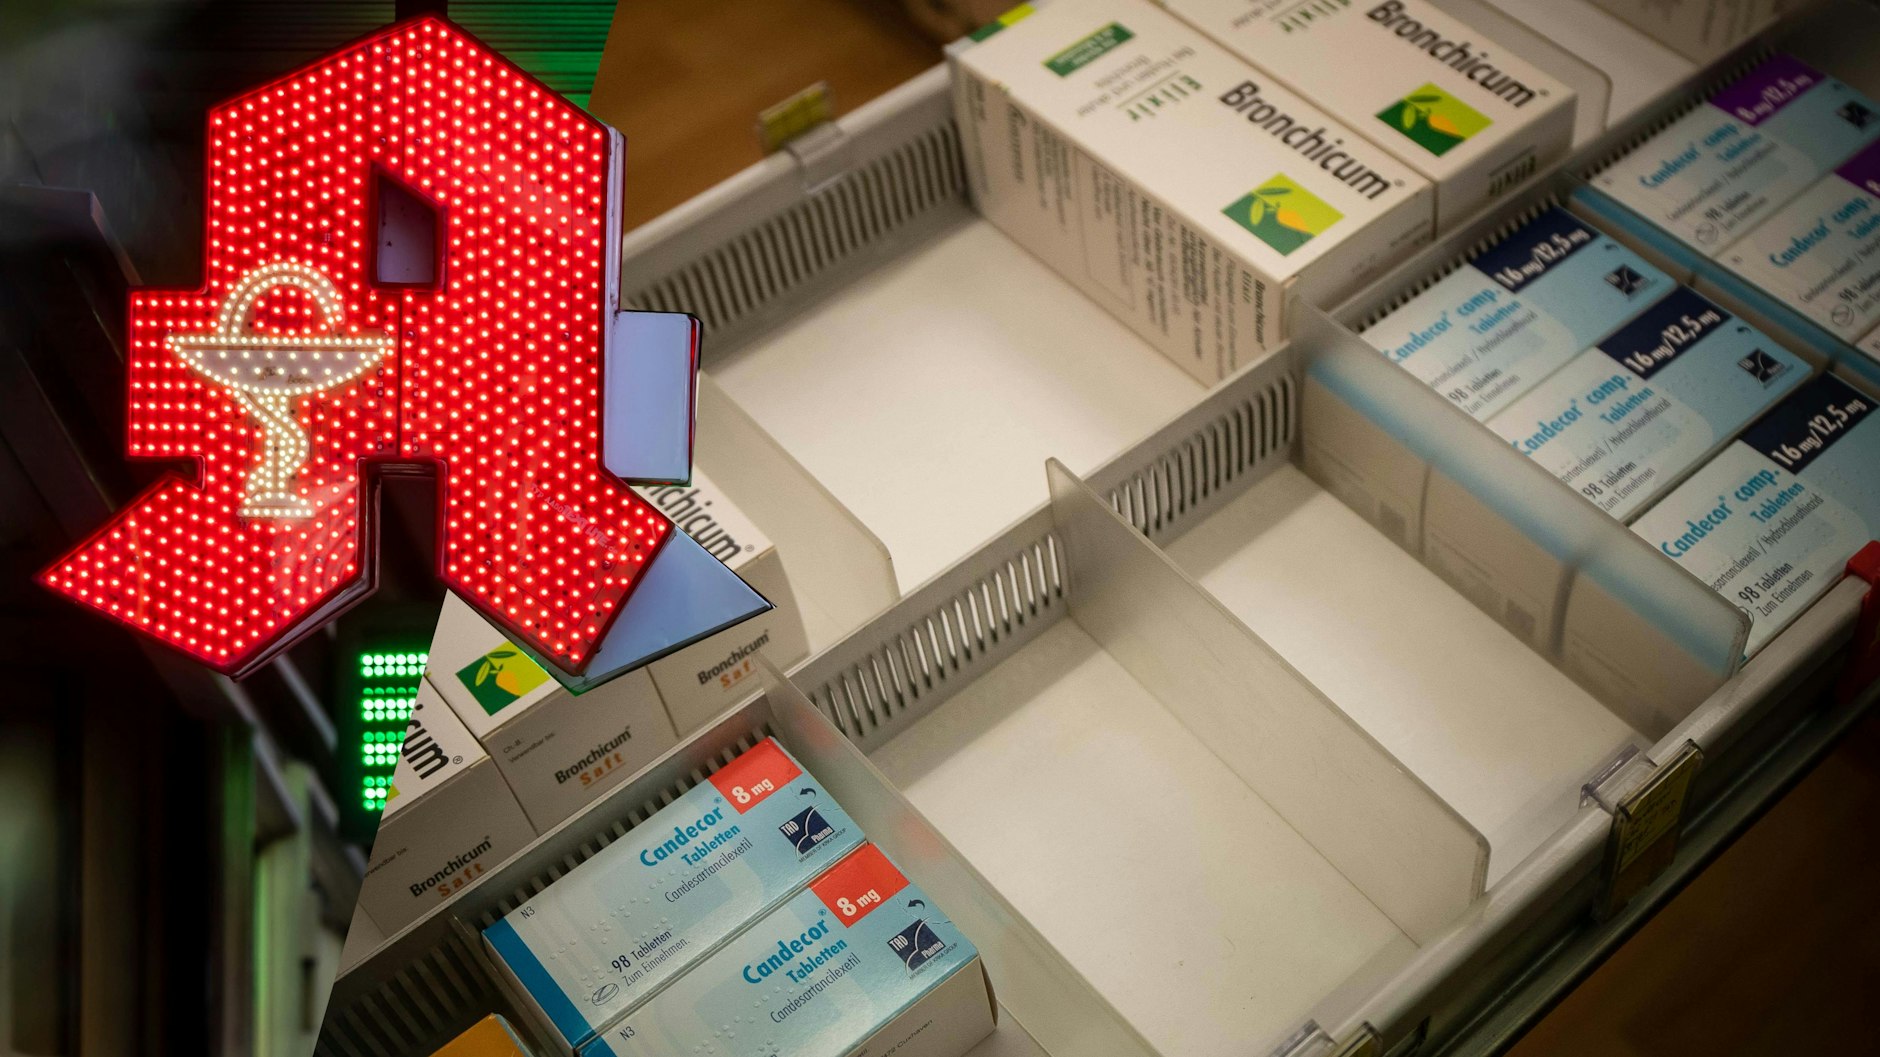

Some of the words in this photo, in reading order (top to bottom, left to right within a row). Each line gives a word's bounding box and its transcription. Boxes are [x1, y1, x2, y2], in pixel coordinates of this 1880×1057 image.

[1127, 75, 1203, 121] Elixir
[1494, 266, 1524, 288] 16
[1468, 299, 1522, 335] Tabletten
[1623, 350, 1655, 374] 16
[1600, 386, 1655, 425] Tabletten
[1771, 444, 1802, 466] 16
[1845, 399, 1868, 416] mg
[1582, 482, 1604, 499] 98
[1599, 460, 1638, 489] Tabletten
[1598, 495, 1620, 512] Zum
[1614, 467, 1657, 500] Einnehmen
[1734, 467, 1781, 504] comp.
[1750, 481, 1805, 524] Tabletten
[1738, 586, 1760, 604] 98
[1755, 562, 1793, 592] Tabletten
[1755, 600, 1779, 617] Zum
[1771, 569, 1814, 603] Einnehmen
[579, 752, 623, 786] Saft
[731, 786, 751, 805] 8
[750, 778, 774, 798] mg
[681, 822, 741, 866] Tabletten
[781, 820, 799, 836] TAD
[811, 826, 833, 843] Pharma
[437, 863, 484, 897] Saft
[664, 837, 753, 903] Candesartancilexetil
[520, 905, 536, 919] N3
[836, 897, 857, 917] 8
[856, 888, 882, 910] mg
[611, 954, 631, 973] 98
[630, 930, 672, 962] Tabletten
[889, 934, 908, 951] TAD
[921, 941, 944, 959] Pharma
[622, 969, 644, 987] Zum
[786, 939, 848, 984] Tabletten
[770, 952, 861, 1024] Candesartancilexetil
[620, 1025, 635, 1041] N3
[896, 1018, 934, 1049] Cuxhaven
